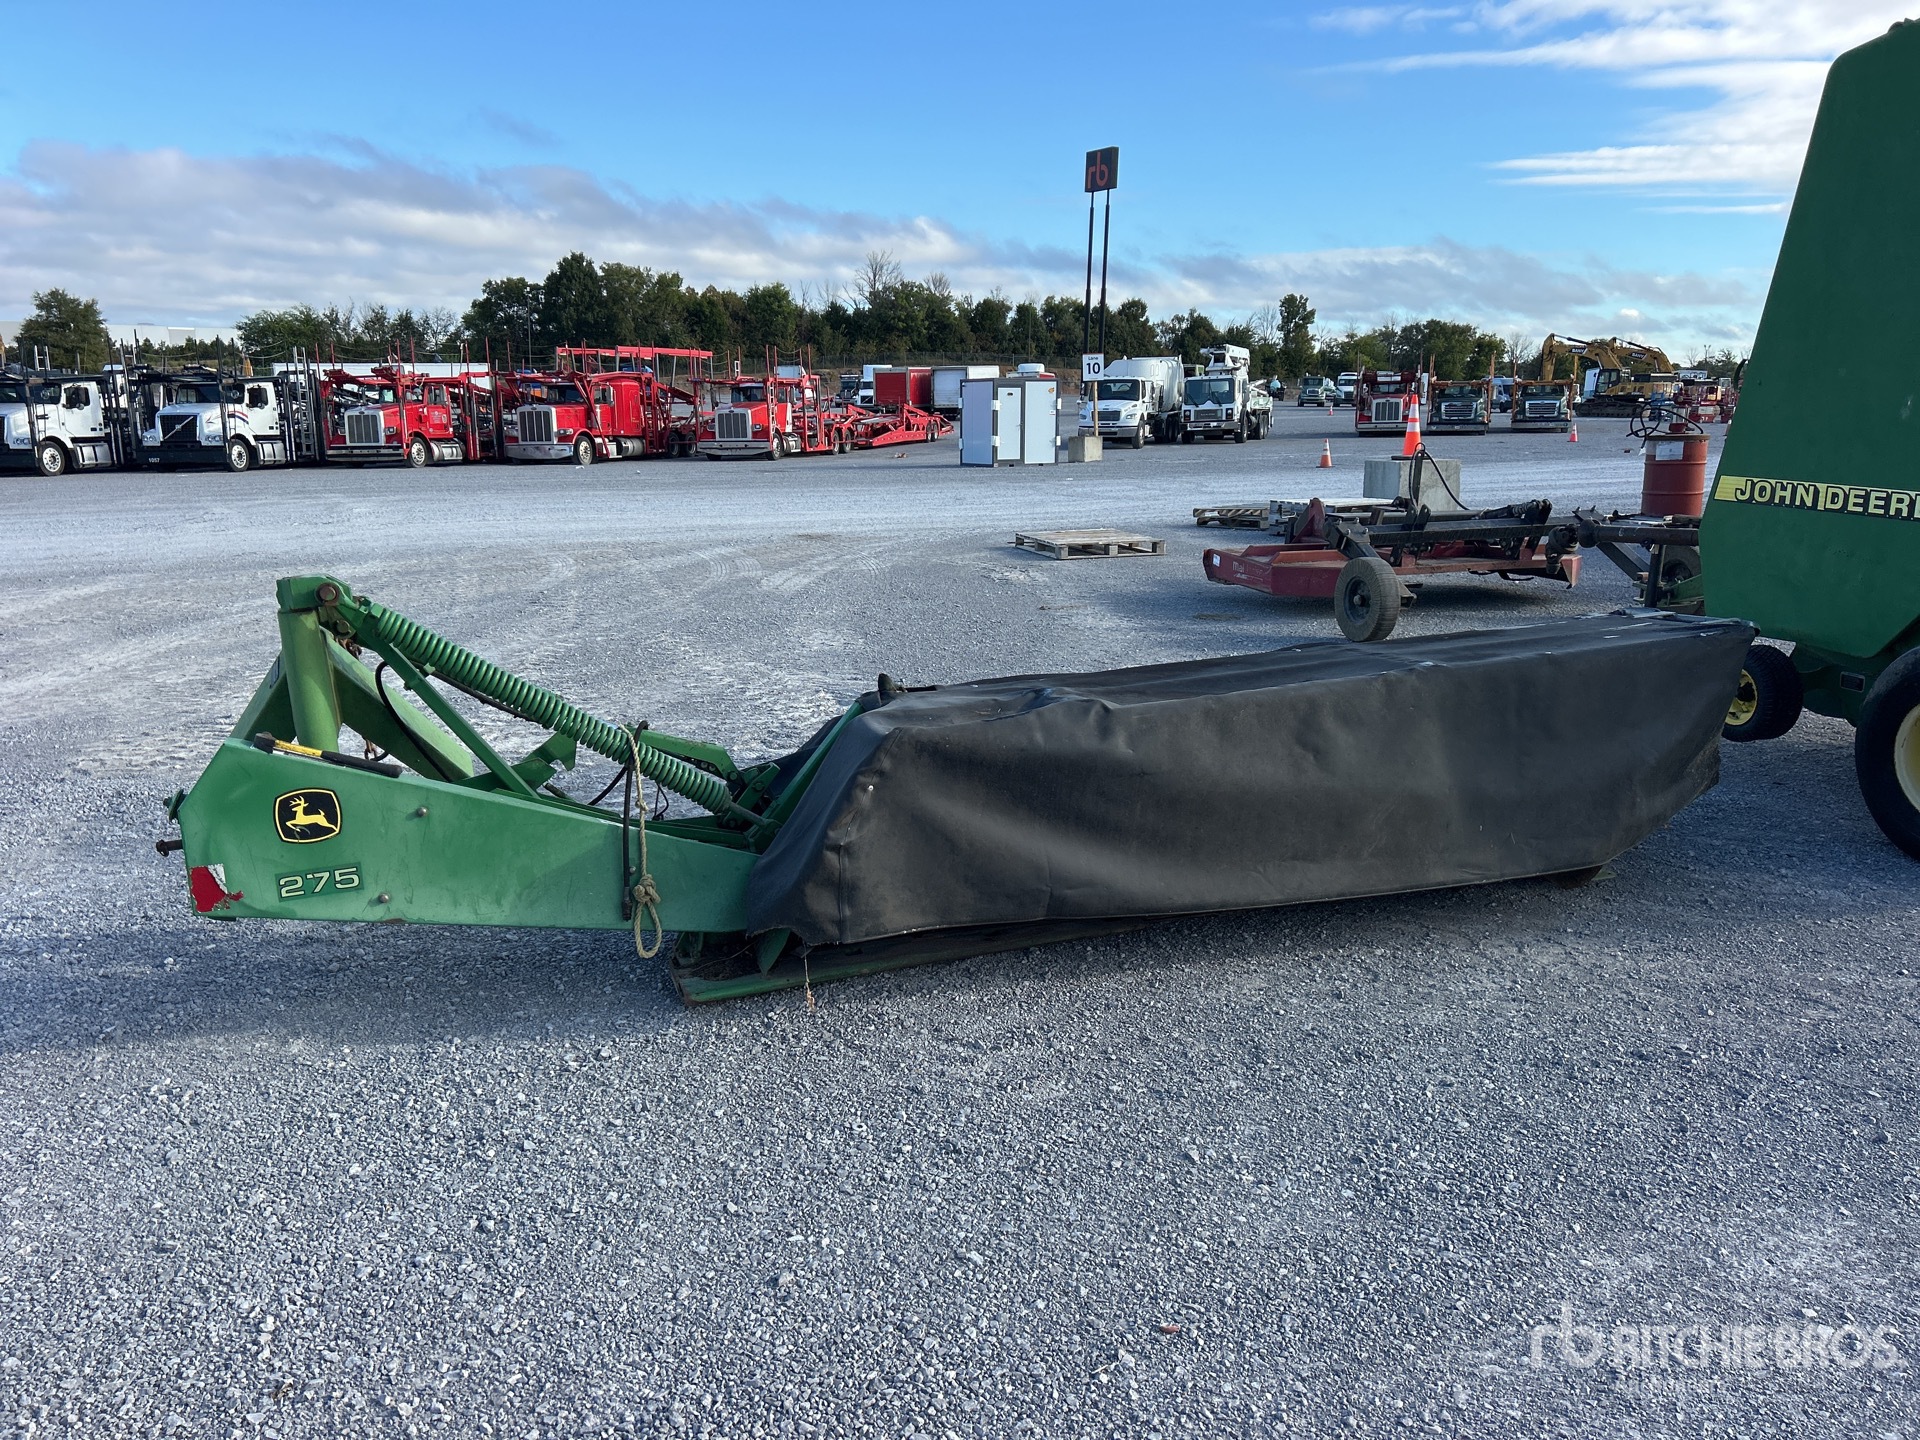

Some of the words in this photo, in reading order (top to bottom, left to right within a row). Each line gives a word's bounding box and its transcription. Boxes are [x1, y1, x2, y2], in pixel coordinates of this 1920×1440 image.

[1087, 151, 1109, 189] rb
[1086, 362, 1101, 375] 10
[1735, 479, 1818, 508] JOHN
[278, 867, 360, 898] 275
